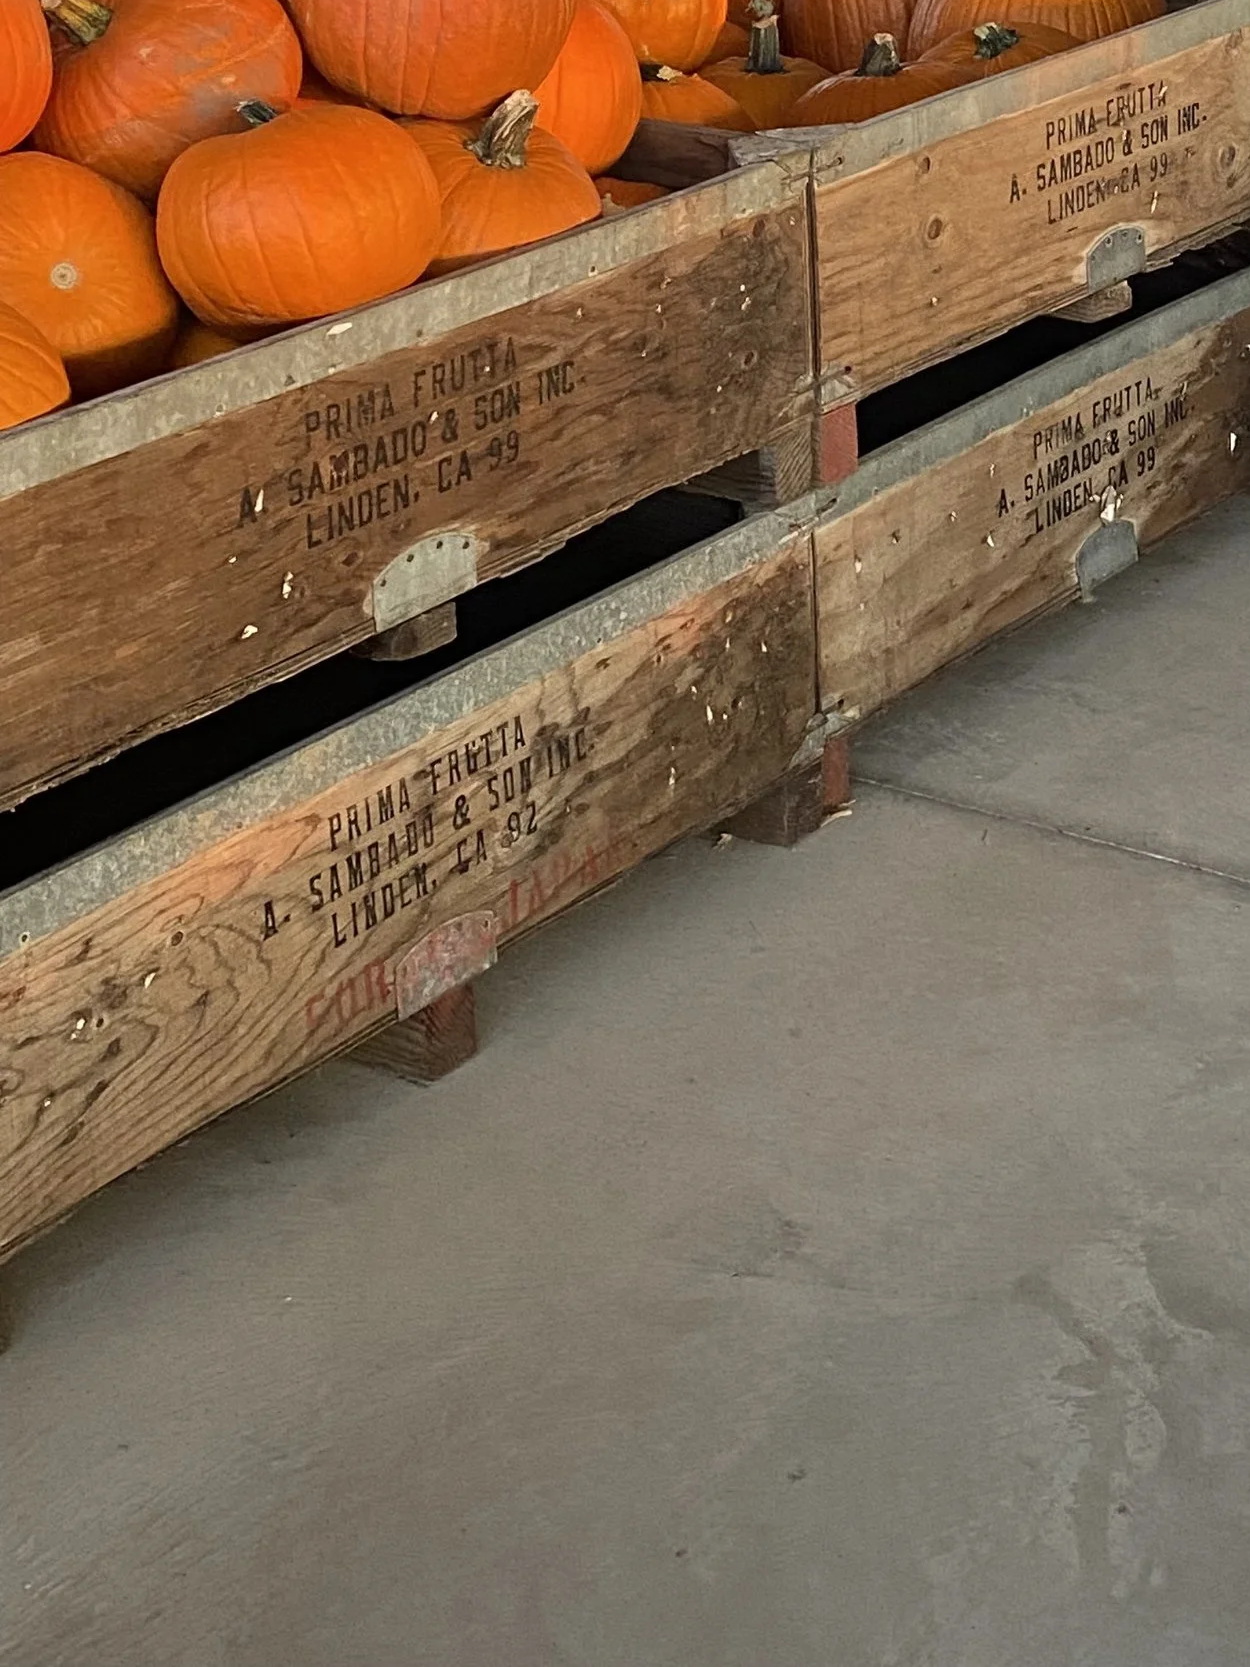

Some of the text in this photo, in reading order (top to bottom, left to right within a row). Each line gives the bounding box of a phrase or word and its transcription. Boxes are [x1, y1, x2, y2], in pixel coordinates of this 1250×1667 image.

[1009, 102, 1207, 203] A. SAMBADO & SON INC.
[1046, 80, 1167, 150] PRIMA FRUTTA
[1121, 162, 1141, 193] CA
[1150, 152, 1168, 182] 99
[287, 421, 426, 507] SAMBADO
[441, 408, 459, 442] &
[474, 381, 521, 430] SON
[537, 360, 586, 406] INC.
[305, 337, 517, 448] PRIMA FRUTTA
[1033, 377, 1154, 460] PRIMA FRUTTA
[438, 449, 473, 494] CA
[488, 430, 520, 472] 99
[998, 488, 1015, 518] A.
[1024, 438, 1101, 502] SAMBADO
[1109, 429, 1120, 455] &
[1128, 410, 1156, 446] SON
[1108, 460, 1128, 491] CA
[1137, 446, 1155, 477] 99
[328, 715, 525, 852] PRIMA FRUTTA
[263, 728, 595, 942] A. SAMBADO & SON INC.
[456, 829, 488, 872] CA
[507, 801, 538, 843] 92
